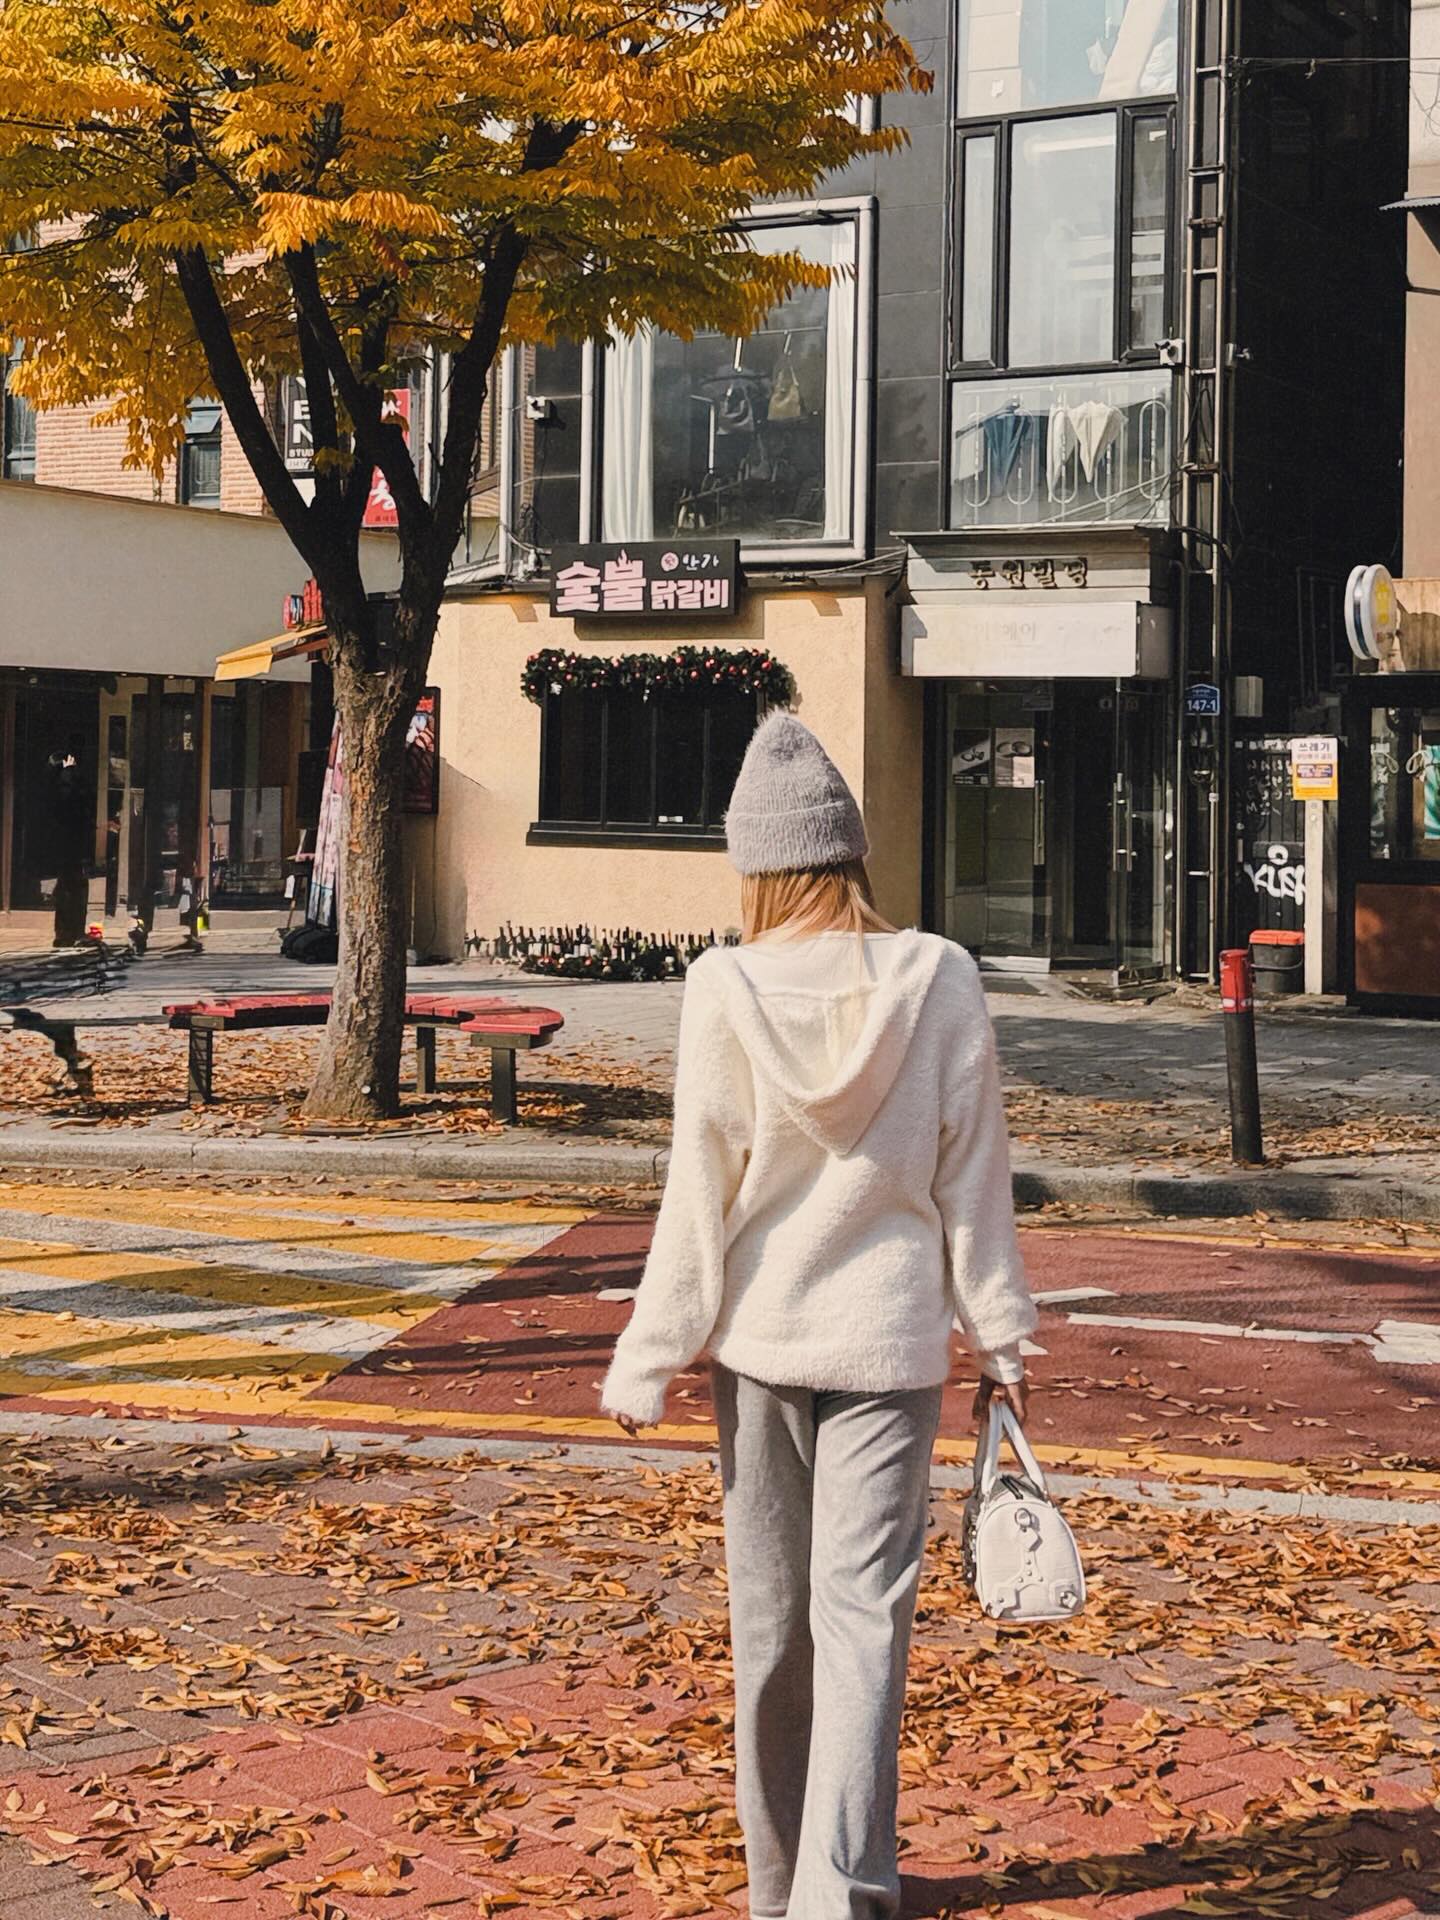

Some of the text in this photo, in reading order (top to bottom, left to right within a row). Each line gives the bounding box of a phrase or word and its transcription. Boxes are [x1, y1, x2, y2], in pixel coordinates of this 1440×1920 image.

[556, 549, 646, 612] 숯불
[651, 579, 729, 609] 닭갈비
[1187, 699, 1216, 711] 147-1
[1299, 742, 1330, 751] 쓰레기
